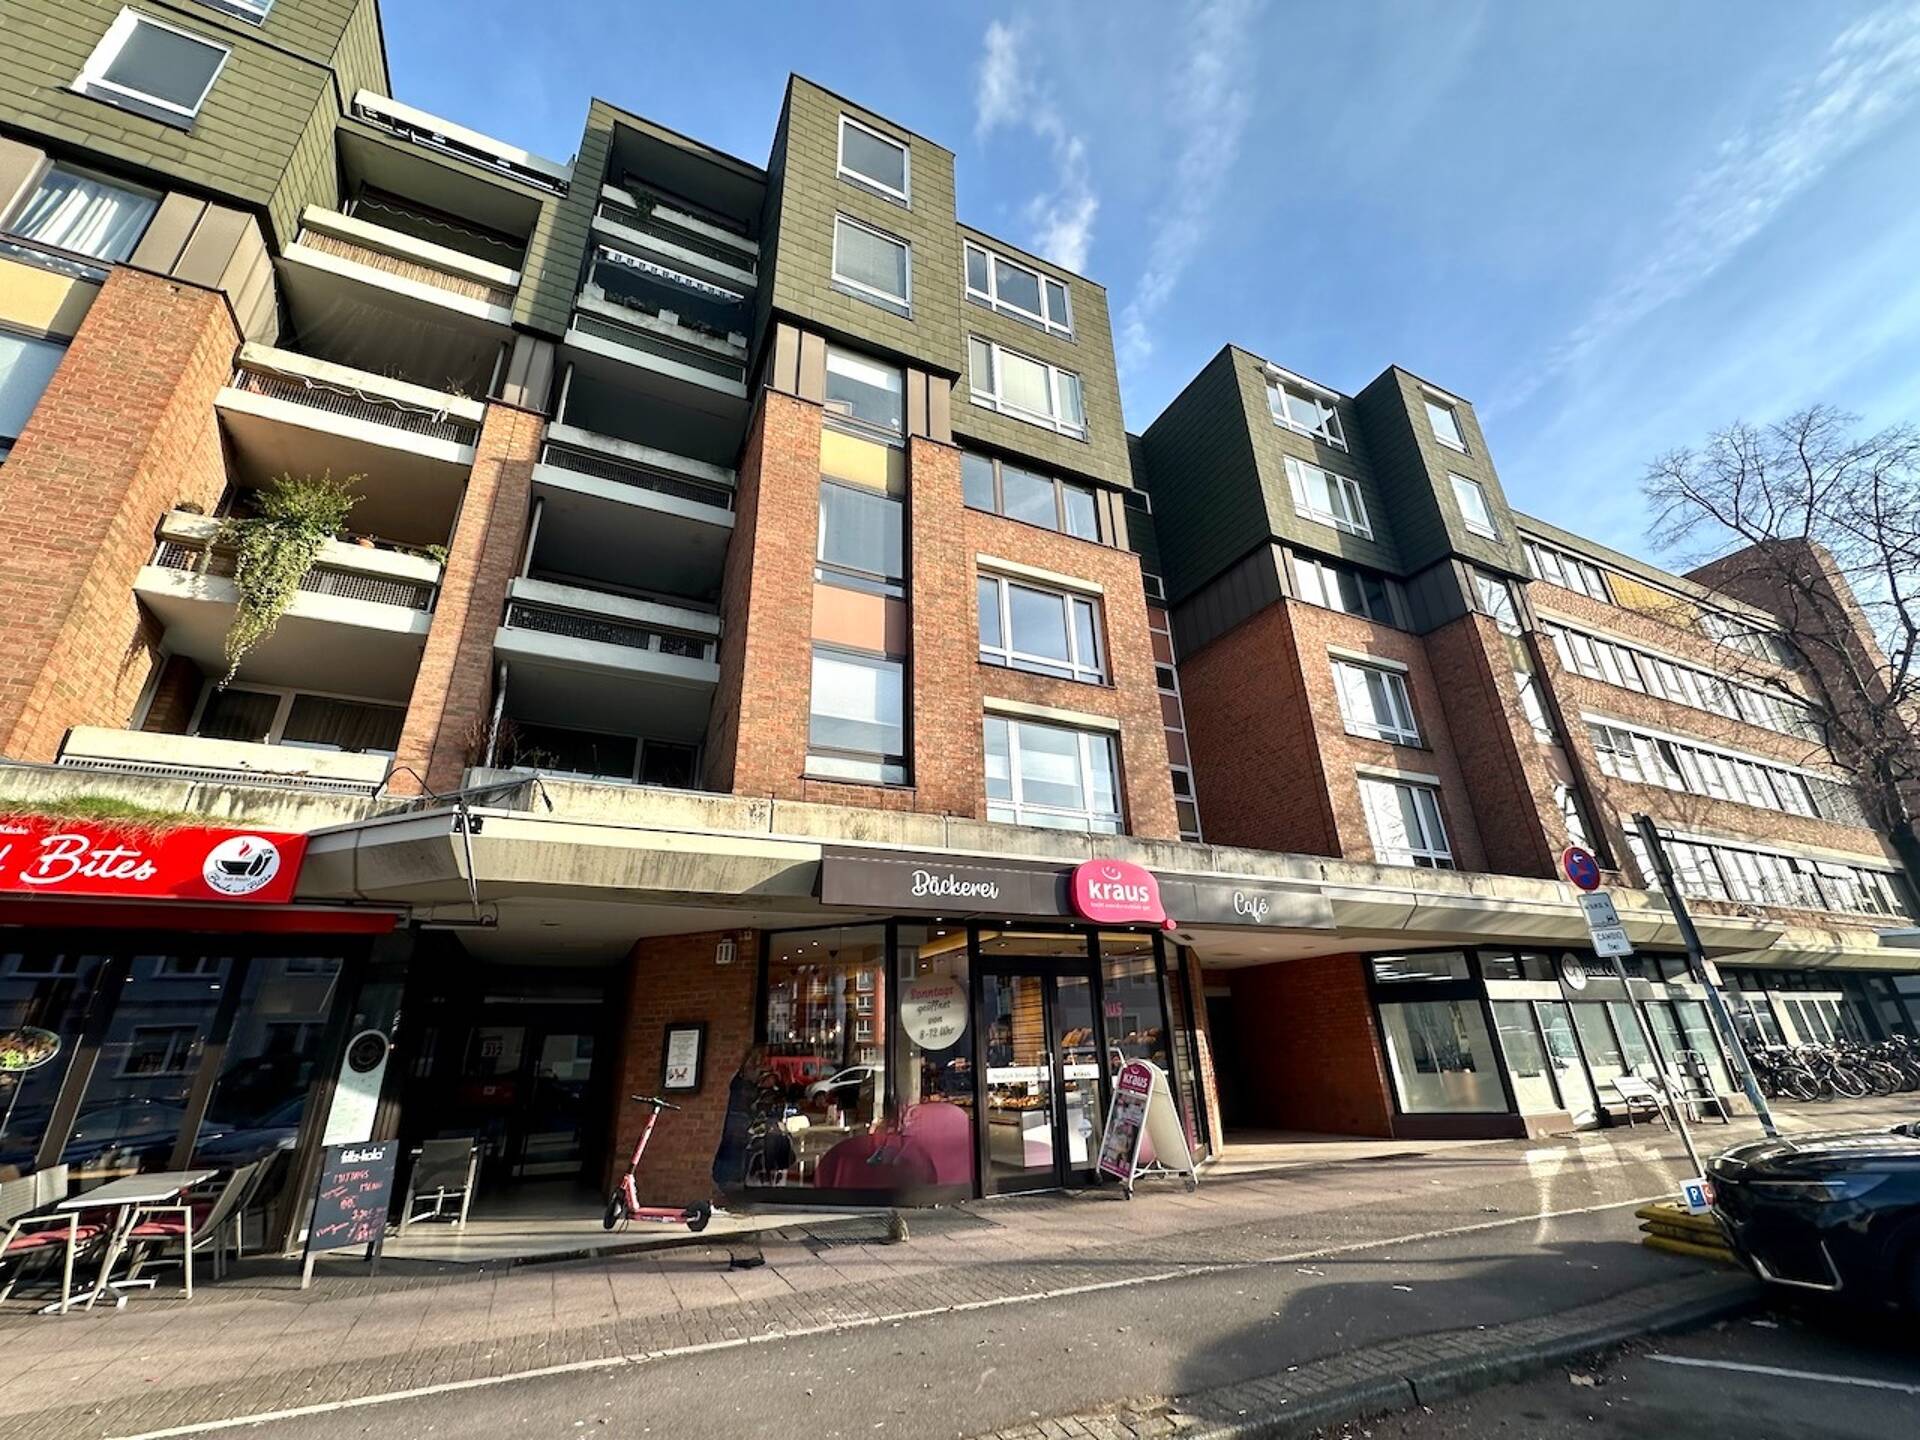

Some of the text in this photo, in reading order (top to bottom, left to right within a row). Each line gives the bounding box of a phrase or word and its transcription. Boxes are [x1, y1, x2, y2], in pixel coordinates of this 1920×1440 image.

[19, 833, 158, 885] Bites
[911, 869, 999, 899] Bäckerei
[1088, 879, 1149, 903] kraus
[1234, 891, 1270, 923] Café
[1121, 1073, 1148, 1089] kraus
